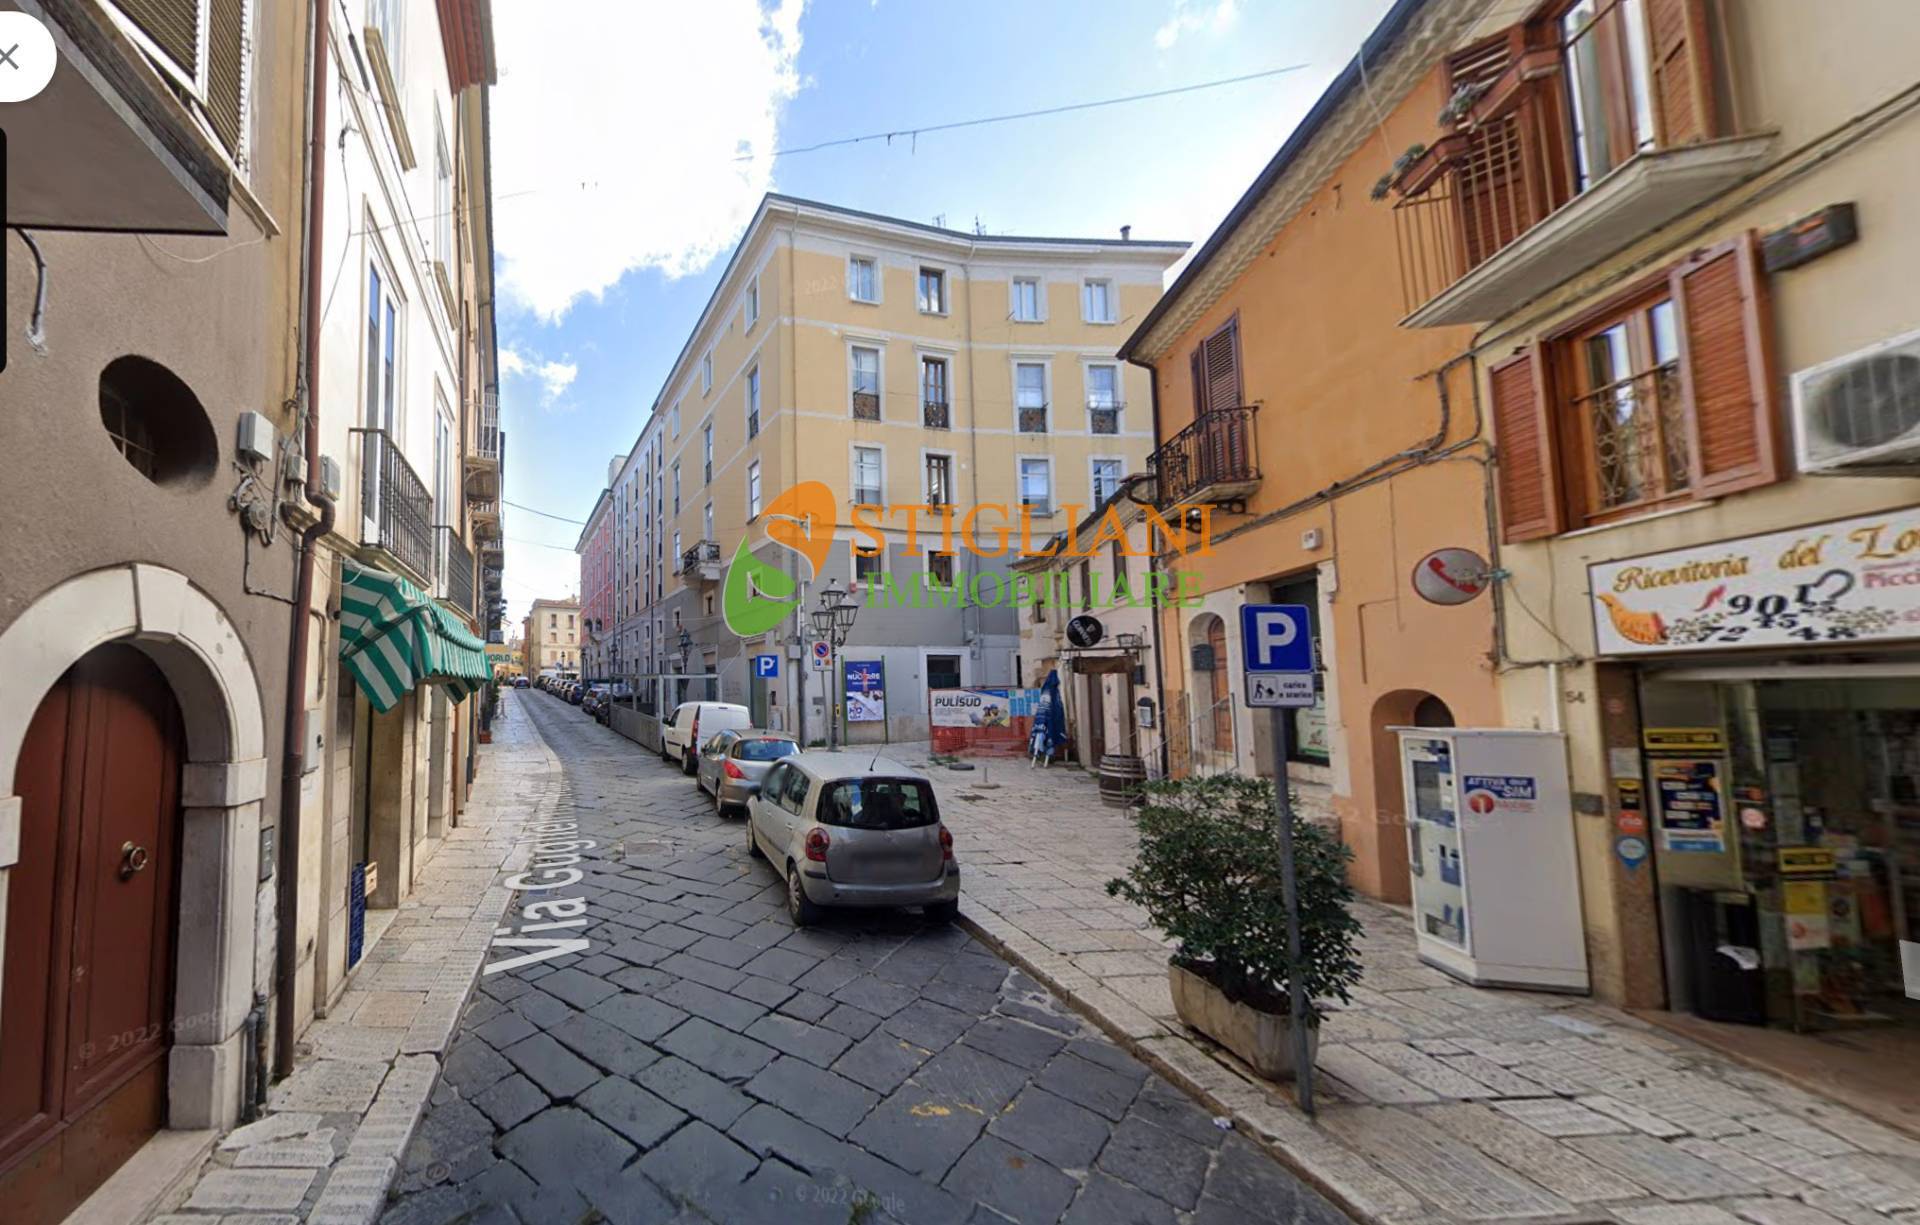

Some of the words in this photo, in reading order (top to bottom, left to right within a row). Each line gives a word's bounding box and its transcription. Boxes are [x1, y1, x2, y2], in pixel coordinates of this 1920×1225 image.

[1778, 534, 1832, 569] del
[1847, 524, 1920, 560] Lo
[1256, 612, 1297, 664] P
[760, 657, 775, 675] P
[1503, 786, 1532, 799] SIM
